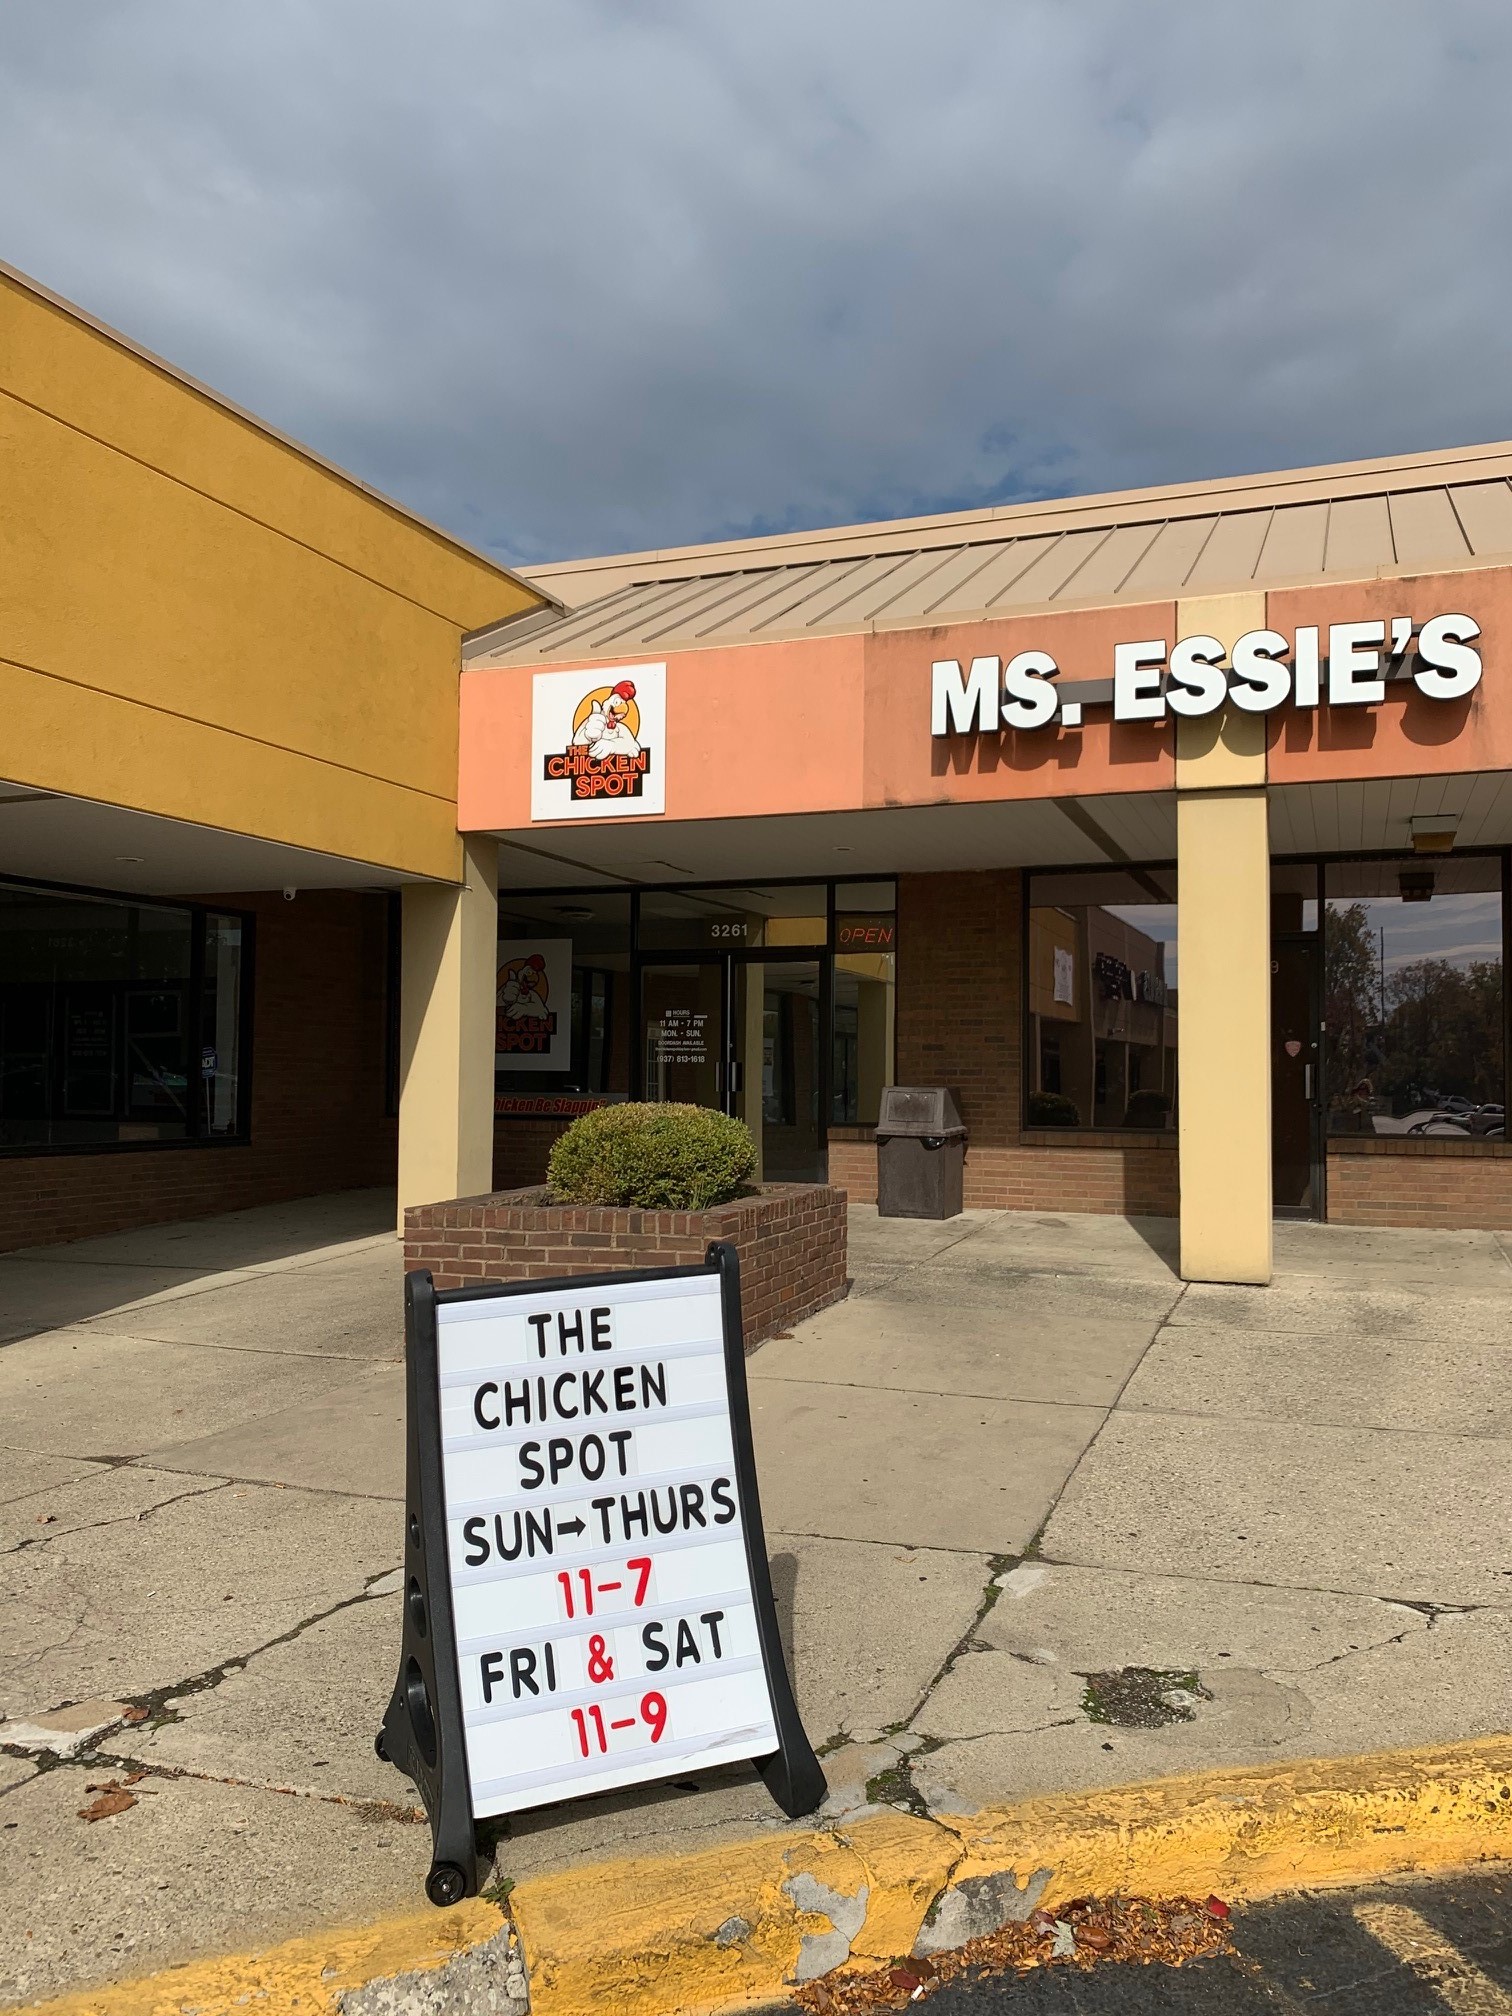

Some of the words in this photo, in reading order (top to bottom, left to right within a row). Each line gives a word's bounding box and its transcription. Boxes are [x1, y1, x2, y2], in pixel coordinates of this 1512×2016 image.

[930, 649, 1084, 737] MS.
[1113, 612, 1483, 721] ESSIE'S
[548, 751, 647, 776] CHICKEN
[567, 745, 588, 757] THE
[575, 772, 639, 797] SPOT
[711, 923, 748, 937] 3261
[840, 928, 894, 943] OPEN
[656, 1055, 675, 1063] (937)
[496, 1096, 534, 1112] hicken
[534, 1097, 551, 1112] Be
[528, 1308, 612, 1358] THE
[474, 1362, 667, 1430] CHICKEN
[519, 1431, 632, 1489] SPOT
[464, 1508, 554, 1567] SUN
[592, 1478, 736, 1544] THURS
[558, 1557, 653, 1619] 11-7
[481, 1643, 556, 1703] FRI
[587, 1634, 615, 1683] &
[643, 1611, 724, 1672] SAT
[571, 1691, 668, 1758] 11-9
